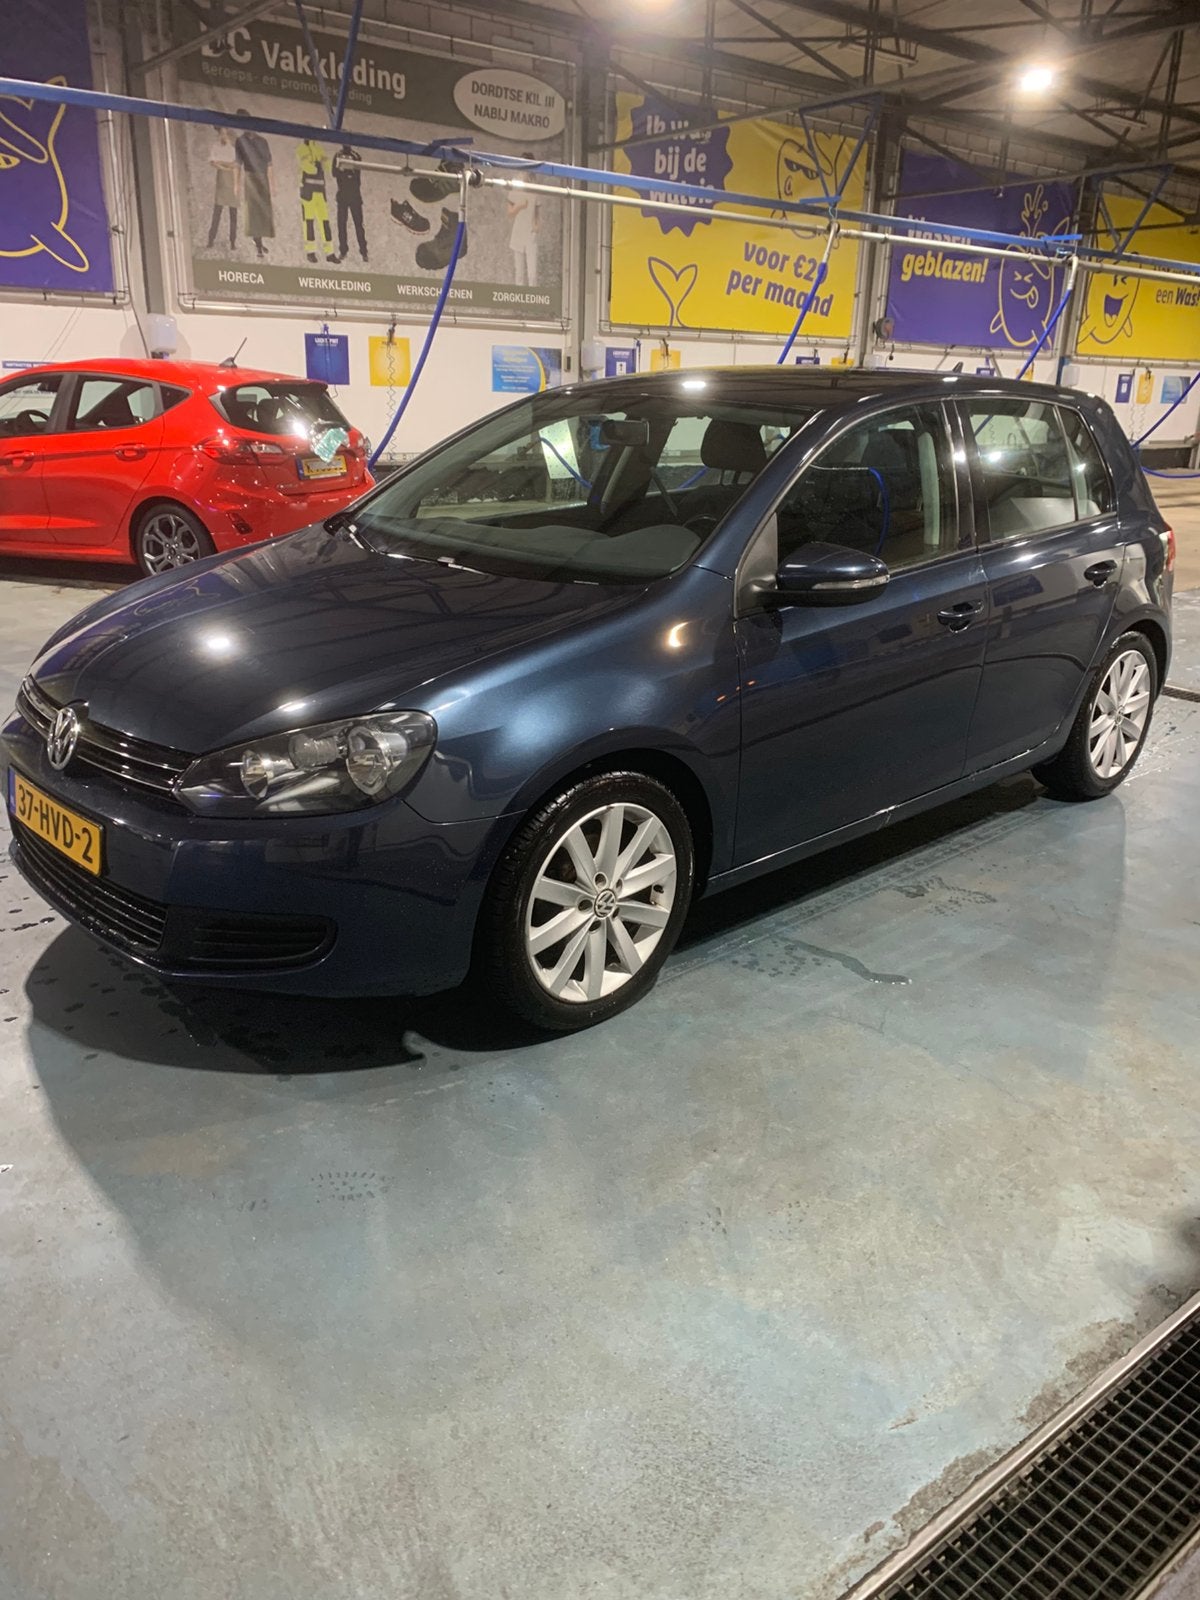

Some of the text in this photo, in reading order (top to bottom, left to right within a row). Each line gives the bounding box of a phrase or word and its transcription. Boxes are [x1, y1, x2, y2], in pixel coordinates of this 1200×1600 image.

[262, 75, 277, 87] en
[281, 79, 372, 105] promoekding
[471, 80, 523, 102] DORDTSE
[525, 91, 541, 106] KIL
[474, 103, 550, 128] NABIJ MAKRO
[654, 146, 707, 180] bij de
[743, 241, 790, 272] voor
[901, 250, 989, 283] geblazen!
[218, 270, 265, 284] HORECA
[298, 277, 372, 292] WERKKLEDING
[397, 284, 473, 299] WERKSCHENEN
[492, 291, 550, 305] ZORGKLEDING
[726, 269, 834, 317] per maand
[1156, 288, 1174, 304] een
[18, 784, 94, 865] 37-HVD-2
